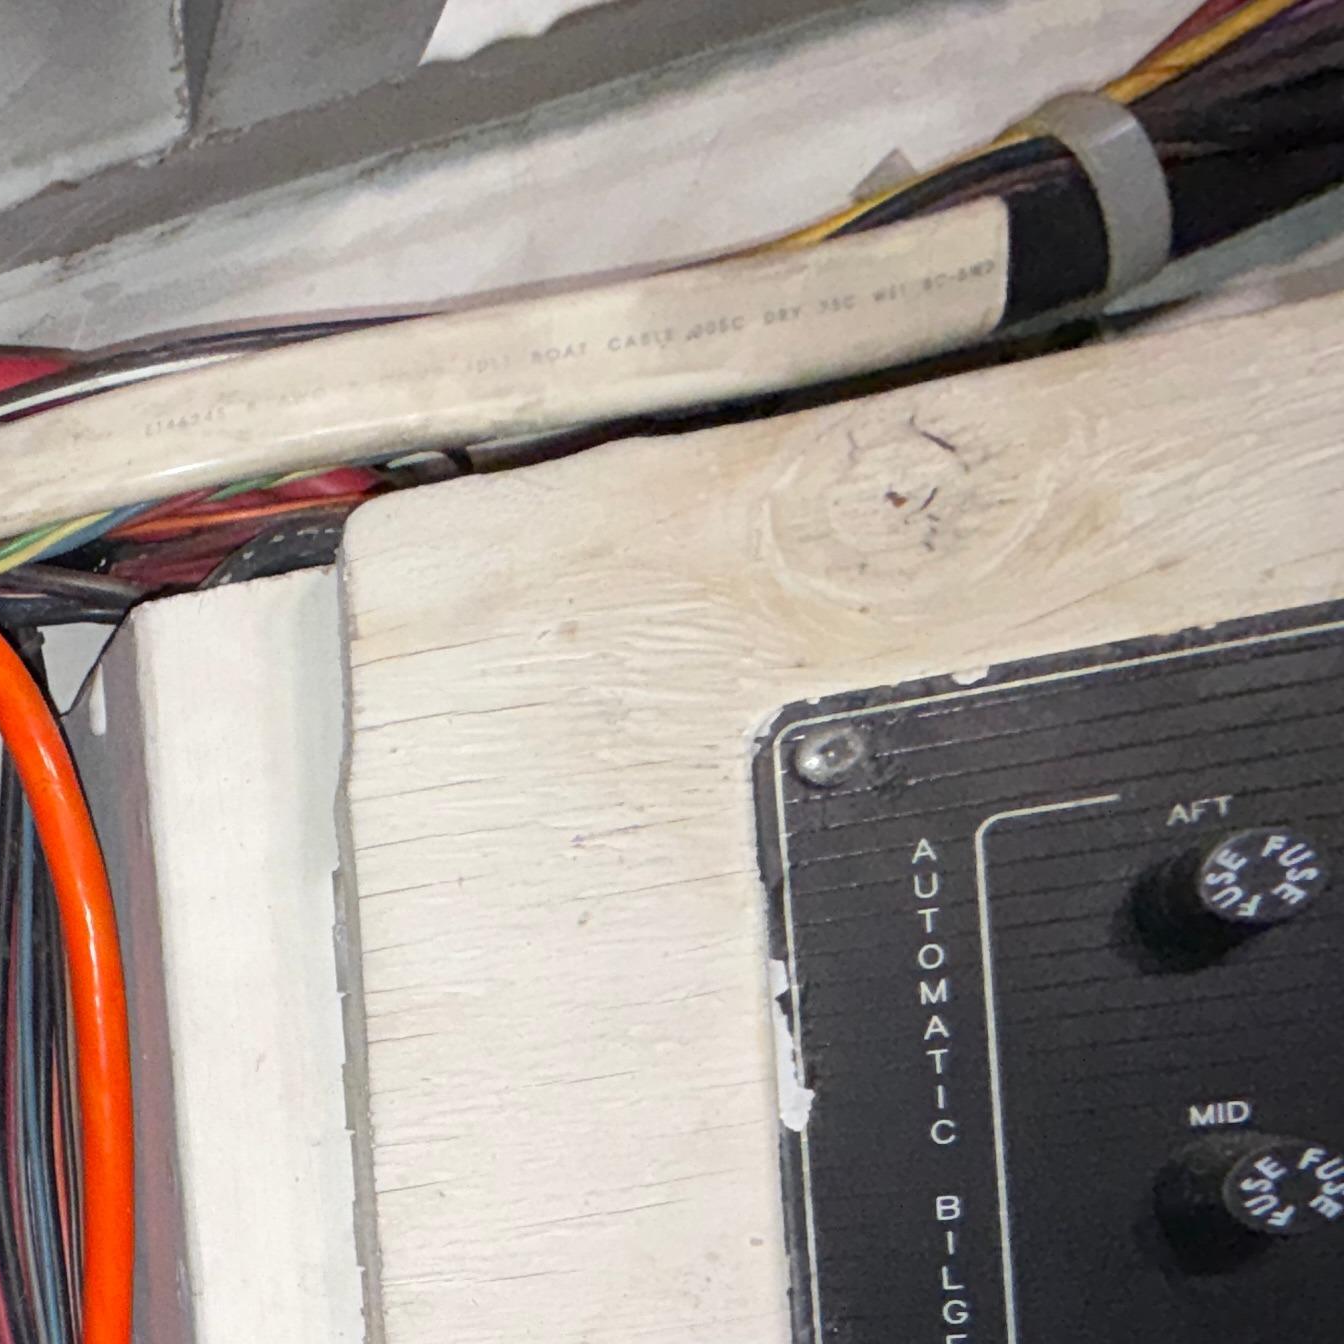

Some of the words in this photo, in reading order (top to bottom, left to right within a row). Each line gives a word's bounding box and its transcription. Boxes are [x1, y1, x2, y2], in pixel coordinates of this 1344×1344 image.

[1166, 796, 1233, 826] AFT
[1205, 847, 1263, 918] FUSE
[1261, 834, 1321, 906] FUSE
[912, 839, 957, 1144] AUTOMATIC
[1189, 1101, 1250, 1127] MID
[1240, 1155, 1296, 1227] FUSE
